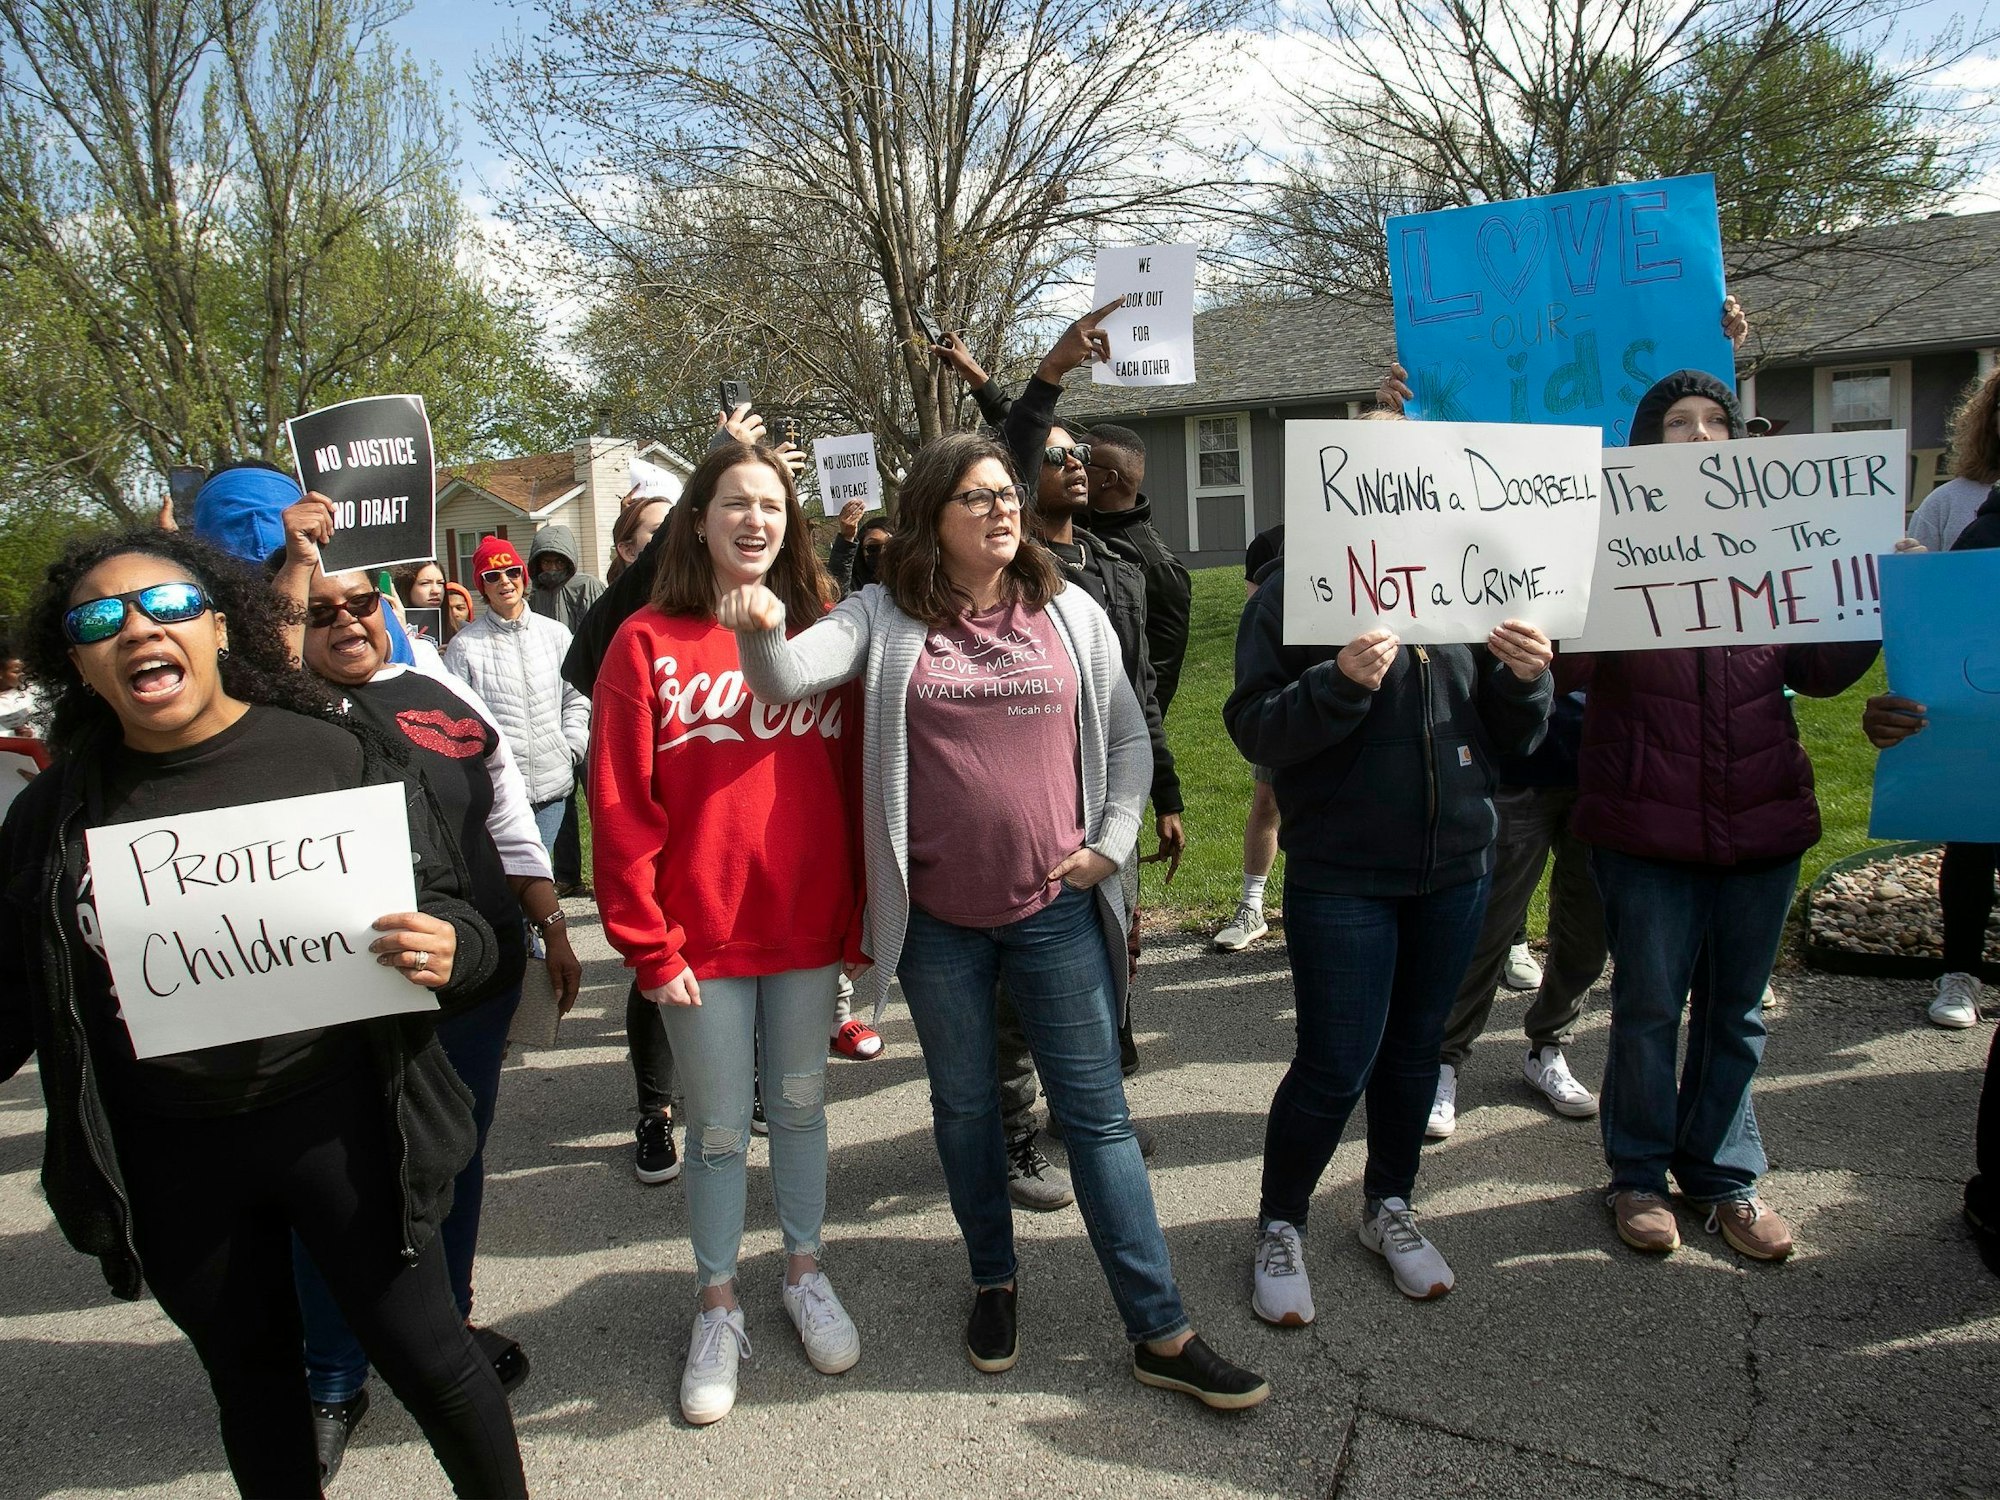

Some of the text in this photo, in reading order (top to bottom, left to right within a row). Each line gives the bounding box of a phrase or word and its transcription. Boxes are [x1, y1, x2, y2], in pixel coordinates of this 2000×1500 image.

[1138, 257, 1151, 273] WE
[1121, 291, 1164, 308] LOOK OUT
[1133, 325, 1150, 342] FOR
[1116, 359, 1170, 377] EACH OTHER
[315, 437, 417, 473] NO JUSTICE
[823, 452, 870, 470] NO JUSTICE
[830, 481, 868, 499] NO PEACE
[1601, 453, 1896, 515] The SHOOTER
[1449, 493, 1464, 510] a
[334, 496, 409, 530] NO DRAFT
[1608, 521, 1841, 568] Should Do The
[488, 553, 513, 568] KC
[1431, 583, 1452, 605] a
[932, 634, 965, 652] ACT
[931, 648, 1047, 675] LOVE MERCY
[917, 677, 1064, 699] WALK HUMBLY
[1008, 703, 1062, 716] Micah 6:8
[142, 914, 356, 997] Children
